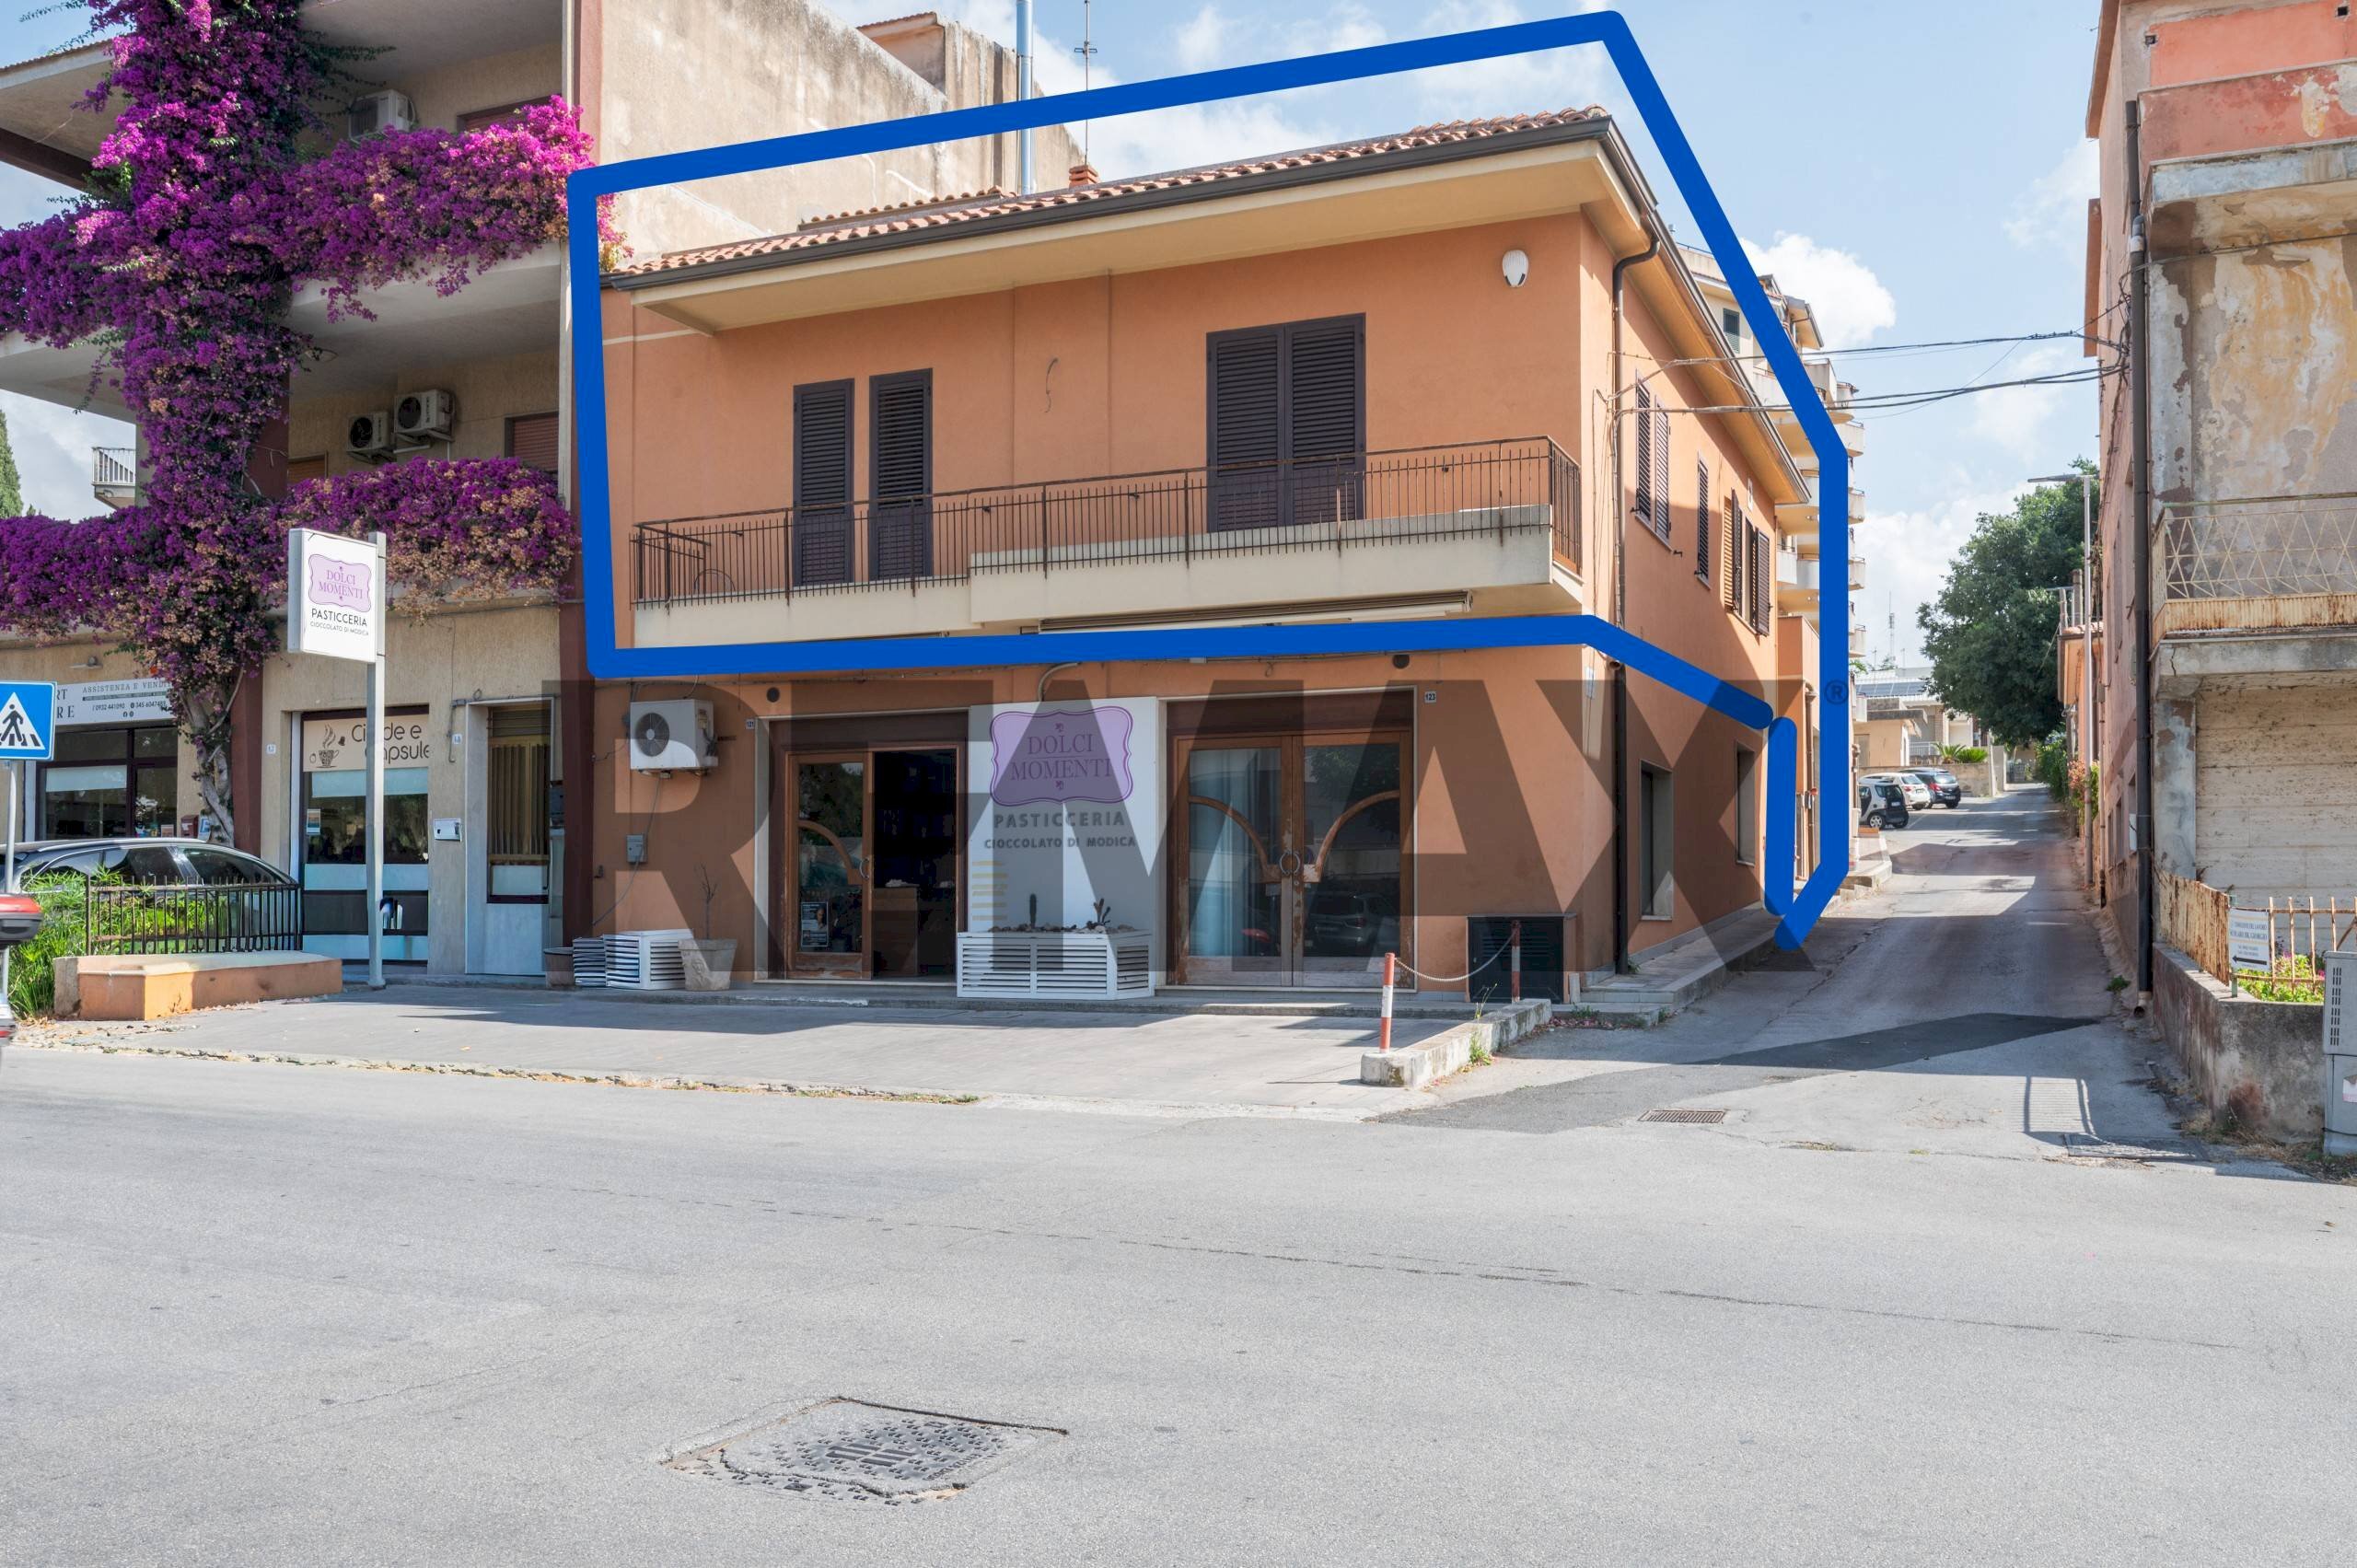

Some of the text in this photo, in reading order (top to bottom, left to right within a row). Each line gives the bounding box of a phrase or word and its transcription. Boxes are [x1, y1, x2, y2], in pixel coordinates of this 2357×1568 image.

[326, 569, 355, 585] DOLCI
[319, 581, 363, 599] MOMENTI
[311, 608, 367, 627] PASTICCERIA
[82, 683, 131, 693] ASSISTENZA
[351, 722, 423, 742] Cide e
[1028, 734, 1094, 755] DOLCI
[1010, 758, 1113, 781] MOMENTI
[993, 811, 1125, 829] PASTICCERIA
[984, 836, 1137, 849] CIOCCOLATO DI MODICA
